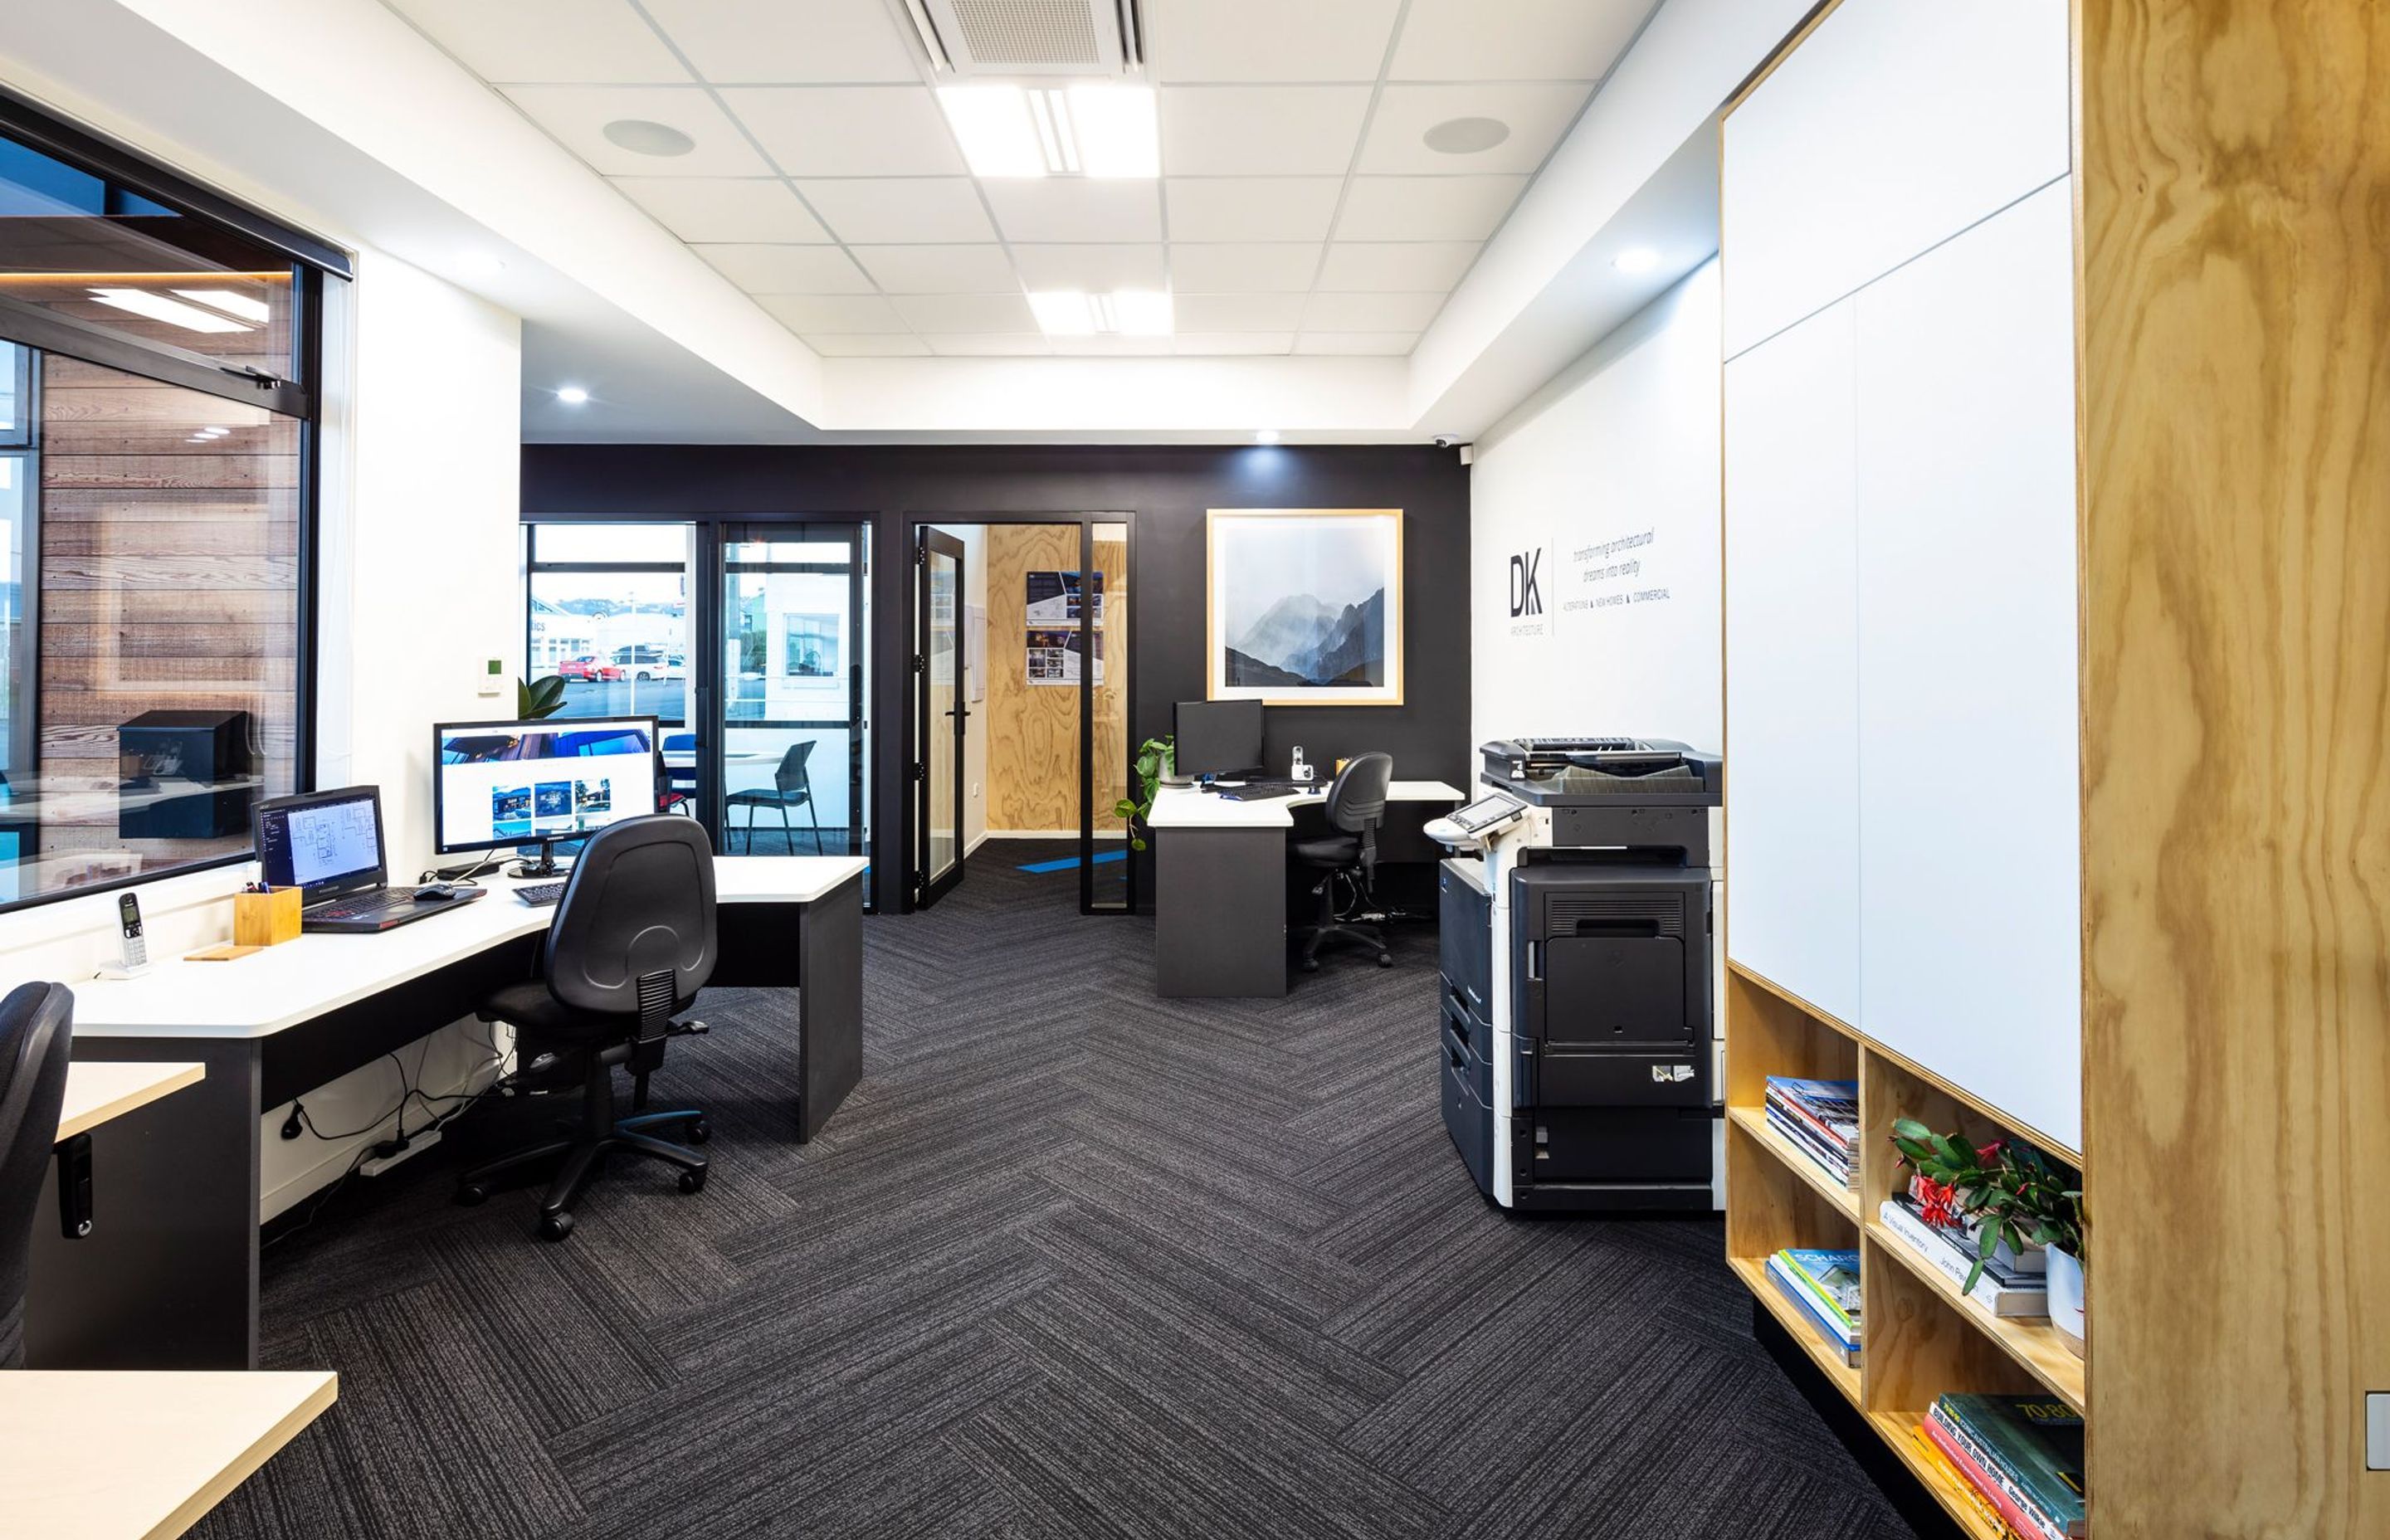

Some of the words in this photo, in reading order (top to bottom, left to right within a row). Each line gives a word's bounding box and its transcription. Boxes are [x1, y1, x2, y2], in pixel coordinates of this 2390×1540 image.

[1510, 547, 1543, 617] DK
[1583, 567, 1605, 582] dreams
[1606, 564, 1618, 578] into
[1619, 558, 1641, 578] reality
[1633, 587, 1671, 603] COMMERCIAL
[1932, 1406, 1957, 1437] BUILDING
[1957, 1431, 1973, 1453] YOUR
[1972, 1448, 1988, 1469] OWN
[1987, 1463, 2005, 1486] HOME
